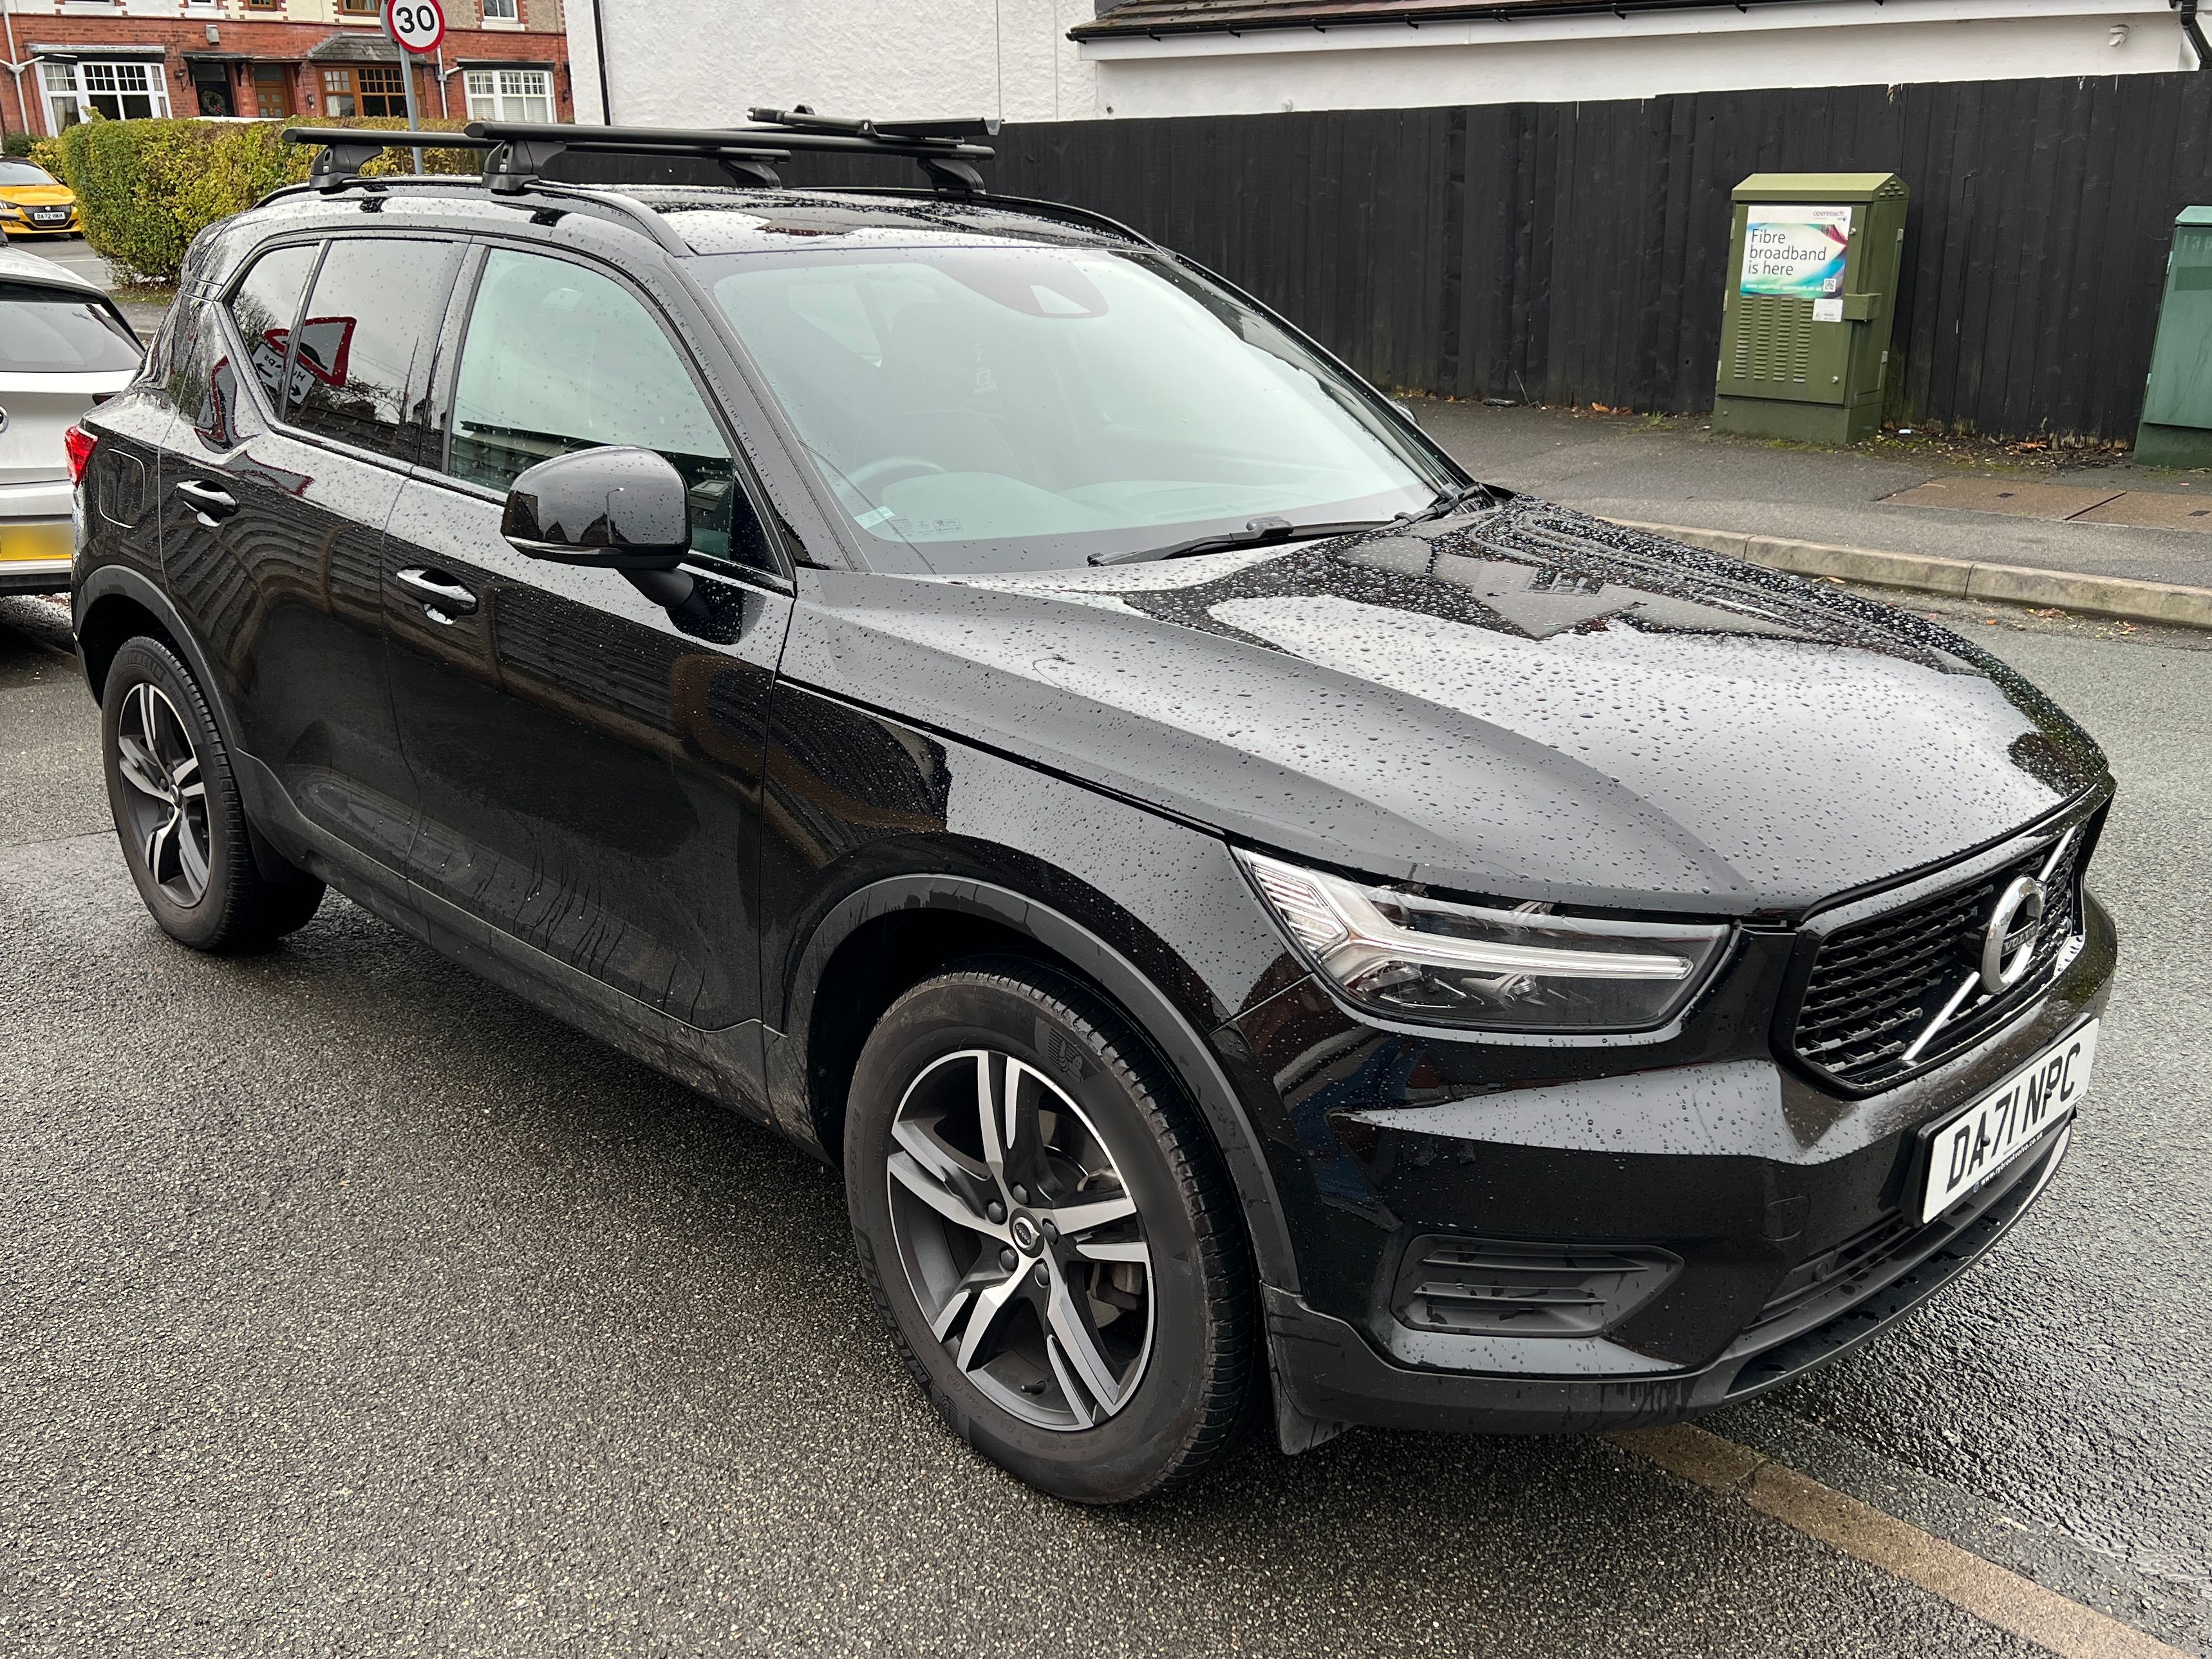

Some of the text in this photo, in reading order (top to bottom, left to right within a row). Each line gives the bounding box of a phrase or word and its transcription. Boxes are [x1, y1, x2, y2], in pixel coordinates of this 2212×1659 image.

[397, 5, 435, 33] 30
[1751, 229, 1786, 244] Fibre
[1750, 244, 1827, 261] broadband
[1748, 260, 1794, 276] is here
[2003, 925, 2037, 952] VOLVO
[1946, 1042, 2081, 1194] DA71 NPC
